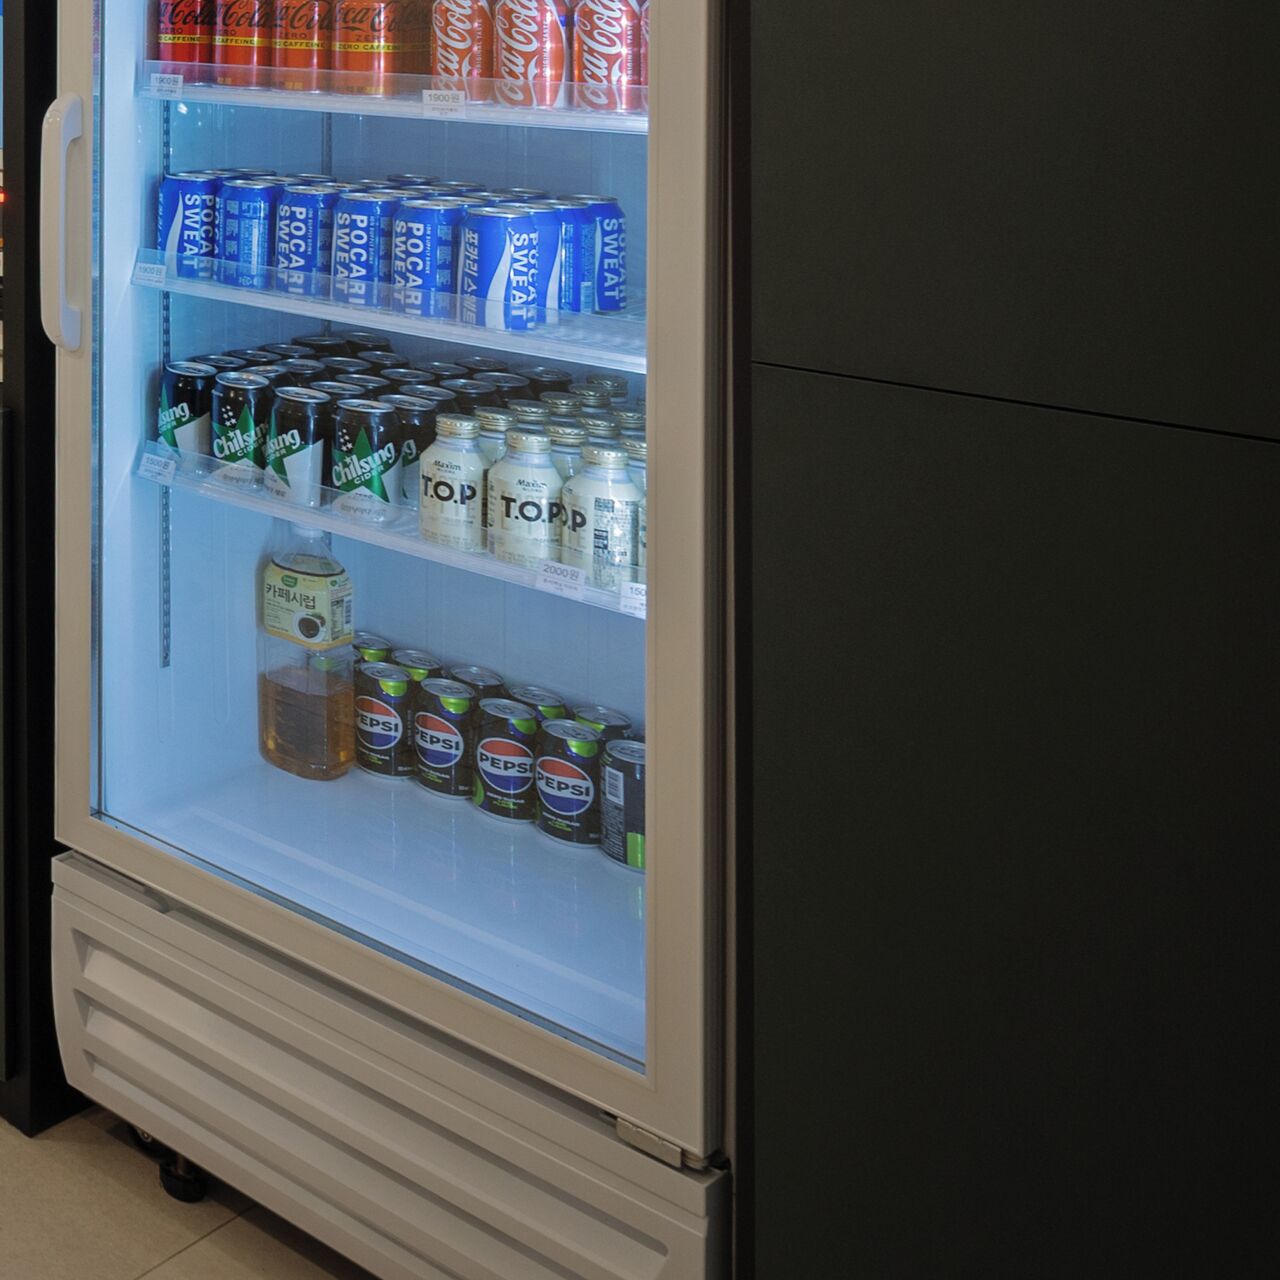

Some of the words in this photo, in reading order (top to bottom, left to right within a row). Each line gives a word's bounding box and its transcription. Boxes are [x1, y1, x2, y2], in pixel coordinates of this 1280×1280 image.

[183, 193, 201, 270] SWEAT
[278, 204, 291, 284] SWEAT
[288, 206, 307, 294] POCARI
[335, 212, 351, 295] SWEAT
[464, 229, 479, 277] 포카리
[348, 214, 369, 305] POCARI
[393, 220, 407, 305] SWEAT
[405, 222, 425, 316] POCARI
[510, 232, 530, 321] SWEAT
[603, 218, 620, 300] SWEAT
[332, 442, 396, 487] Chilsung
[432, 460, 462, 472] Maxim
[422, 474, 477, 505] T.O.P
[501, 495, 562, 524] T.O.P
[265, 583, 316, 610] 카페시럽
[543, 564, 579, 581] 2000원
[629, 586, 647, 597] 150
[360, 714, 400, 733] EPSI
[537, 770, 590, 798] PEPSI
